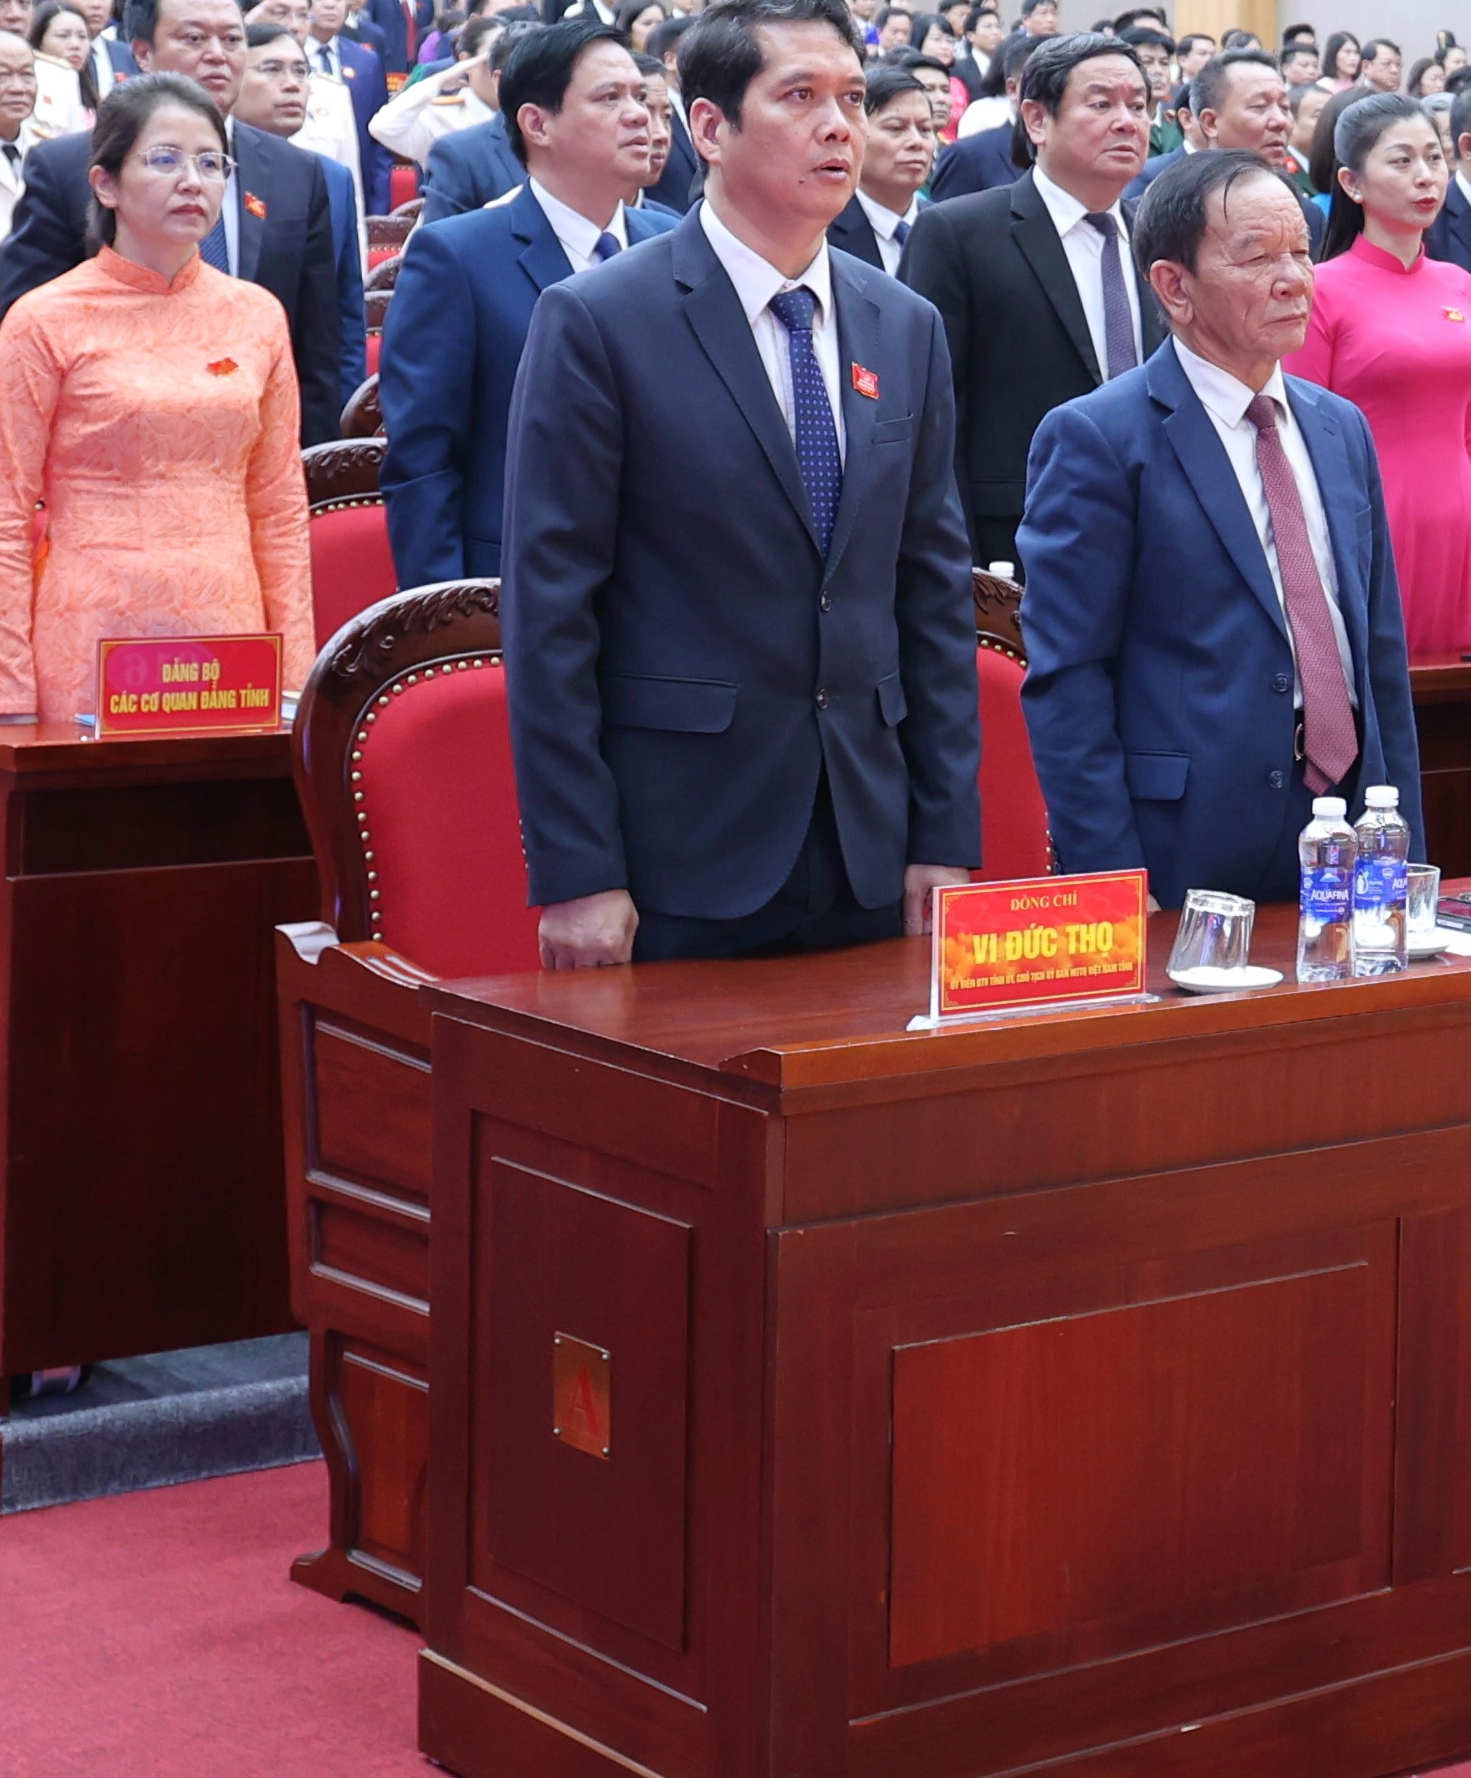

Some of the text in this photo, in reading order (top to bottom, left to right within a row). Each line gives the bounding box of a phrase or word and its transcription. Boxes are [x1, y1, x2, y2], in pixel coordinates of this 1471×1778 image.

[162, 657, 221, 683] ĐẢNG BỘ
[110, 681, 270, 714] CÁC CƠ QUAN ĐẢNG TỈNH
[1010, 890, 1078, 911] ĐỒNG CHÍ
[1311, 889, 1349, 901] AQUAFINA
[972, 921, 1114, 964] VI ĐỨC THỌ
[565, 1363, 600, 1438] A
